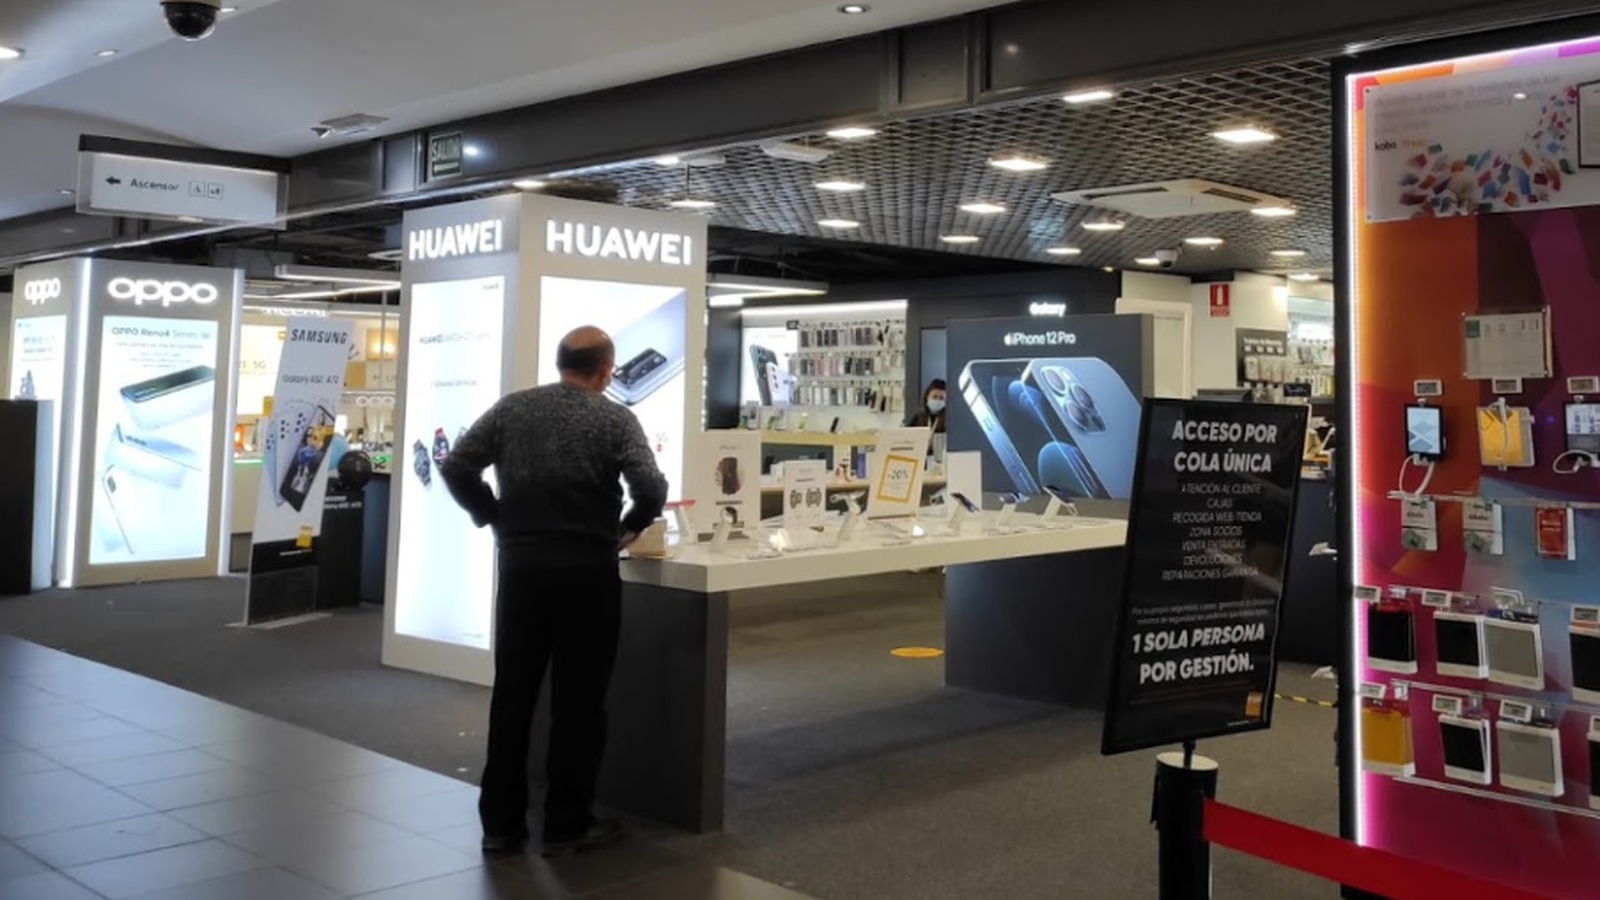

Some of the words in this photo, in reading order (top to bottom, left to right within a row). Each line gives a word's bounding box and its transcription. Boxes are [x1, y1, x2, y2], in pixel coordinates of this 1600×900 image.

[1374, 140, 1397, 151] kobo
[130, 178, 180, 192] Ascensor
[409, 219, 502, 261] HUAWEI
[547, 220, 692, 265] HUAWEI
[24, 277, 61, 305] oppo
[107, 277, 218, 307] oppo
[1029, 302, 1066, 318] Galaxy
[111, 327, 139, 336] OPPO
[140, 328, 170, 338] Reno4
[290, 329, 348, 345] SAMSUNG
[1012, 332, 1046, 346] iPhone
[1046, 330, 1057, 345] 12
[1057, 331, 1076, 345] Pro
[282, 373, 309, 385] Galaxy
[1172, 420, 1242, 442] ACCESO
[1244, 423, 1278, 443] POR
[1174, 451, 1220, 472] COLA
[1223, 447, 1272, 472] ÚNICA
[1222, 484, 1230, 494] AL
[1232, 483, 1262, 494] CLIENTE
[1206, 498, 1233, 509] CAJAS
[1172, 511, 1214, 523] RECOGIDA
[1189, 527, 1211, 537] ZONA
[1213, 525, 1243, 536] SOCIOS
[1182, 540, 1206, 551] VENTA
[1208, 539, 1246, 550] ENTRADAS
[1162, 568, 1221, 581] REPARACIONES
[1132, 634, 1141, 653] 1
[1143, 630, 1188, 653] SOLA
[1191, 622, 1265, 647] PERSONA
[1140, 661, 1177, 684] POR
[1179, 648, 1255, 679] GESTIÓN.
